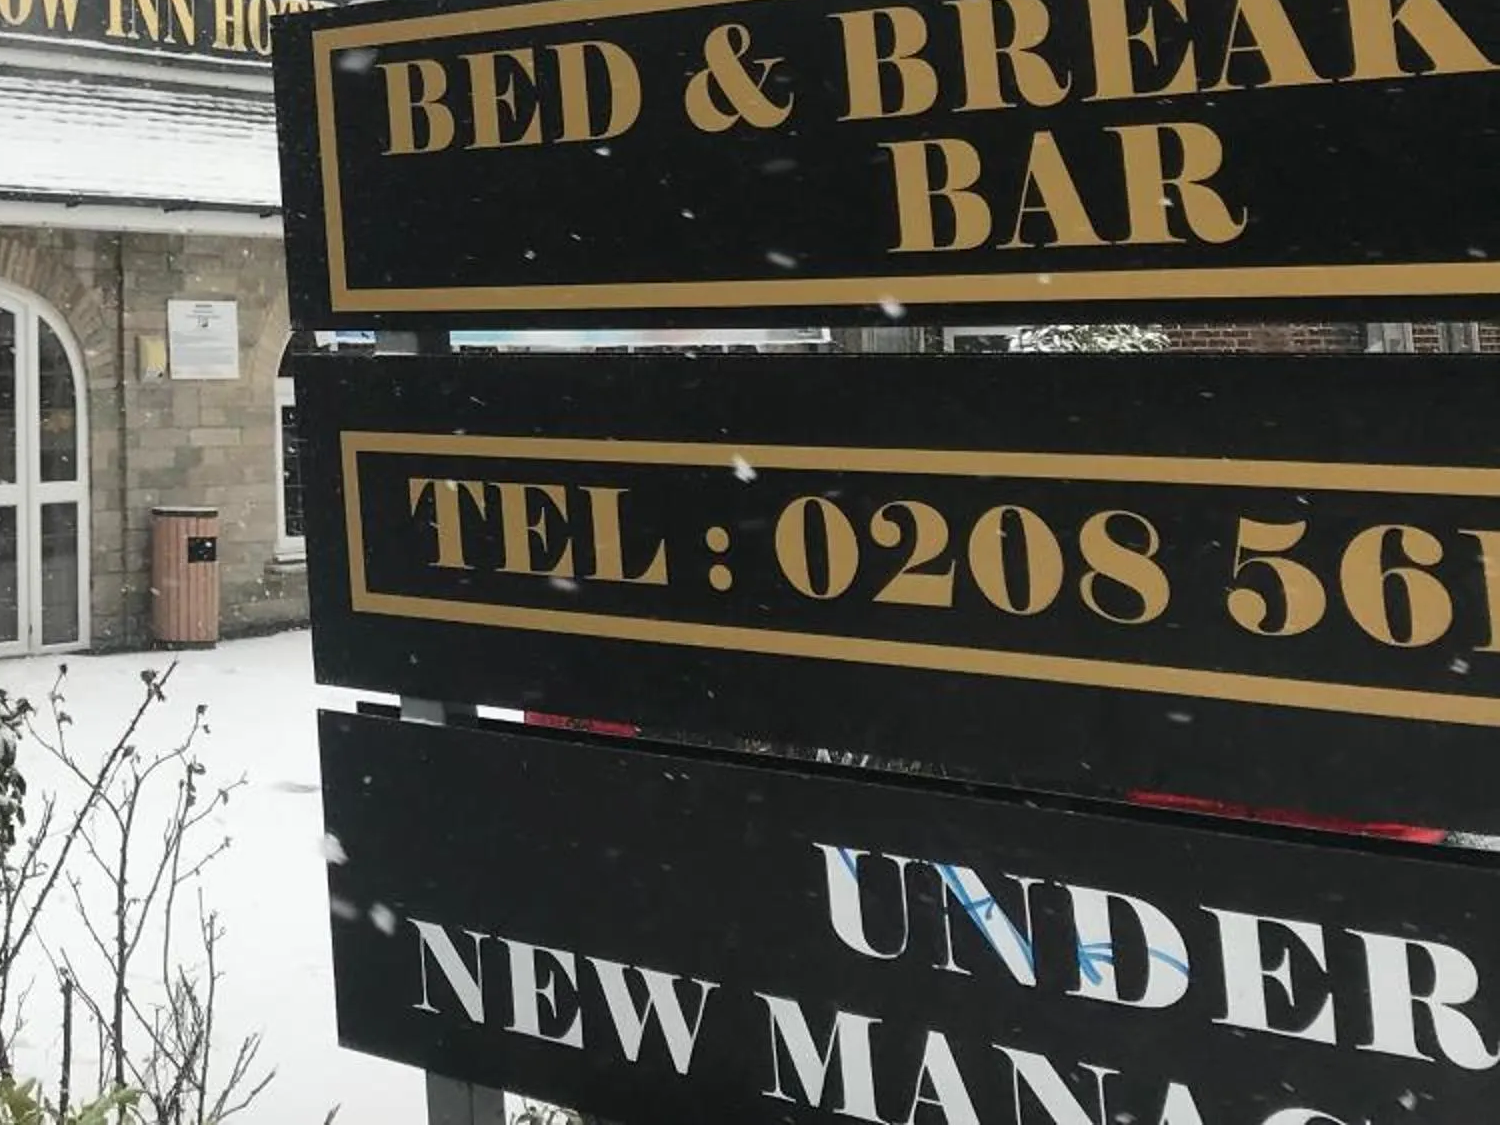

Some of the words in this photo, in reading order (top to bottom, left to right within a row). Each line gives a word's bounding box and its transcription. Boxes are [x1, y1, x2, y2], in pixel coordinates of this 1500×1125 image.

[377, 39, 643, 156] BED
[684, 22, 795, 134] &
[878, 119, 1248, 254] BAR
[773, 494, 1172, 626] 0208
[406, 916, 721, 1075] NEW
[753, 991, 1372, 1125] MAN
[813, 842, 1500, 1072] UNDER
